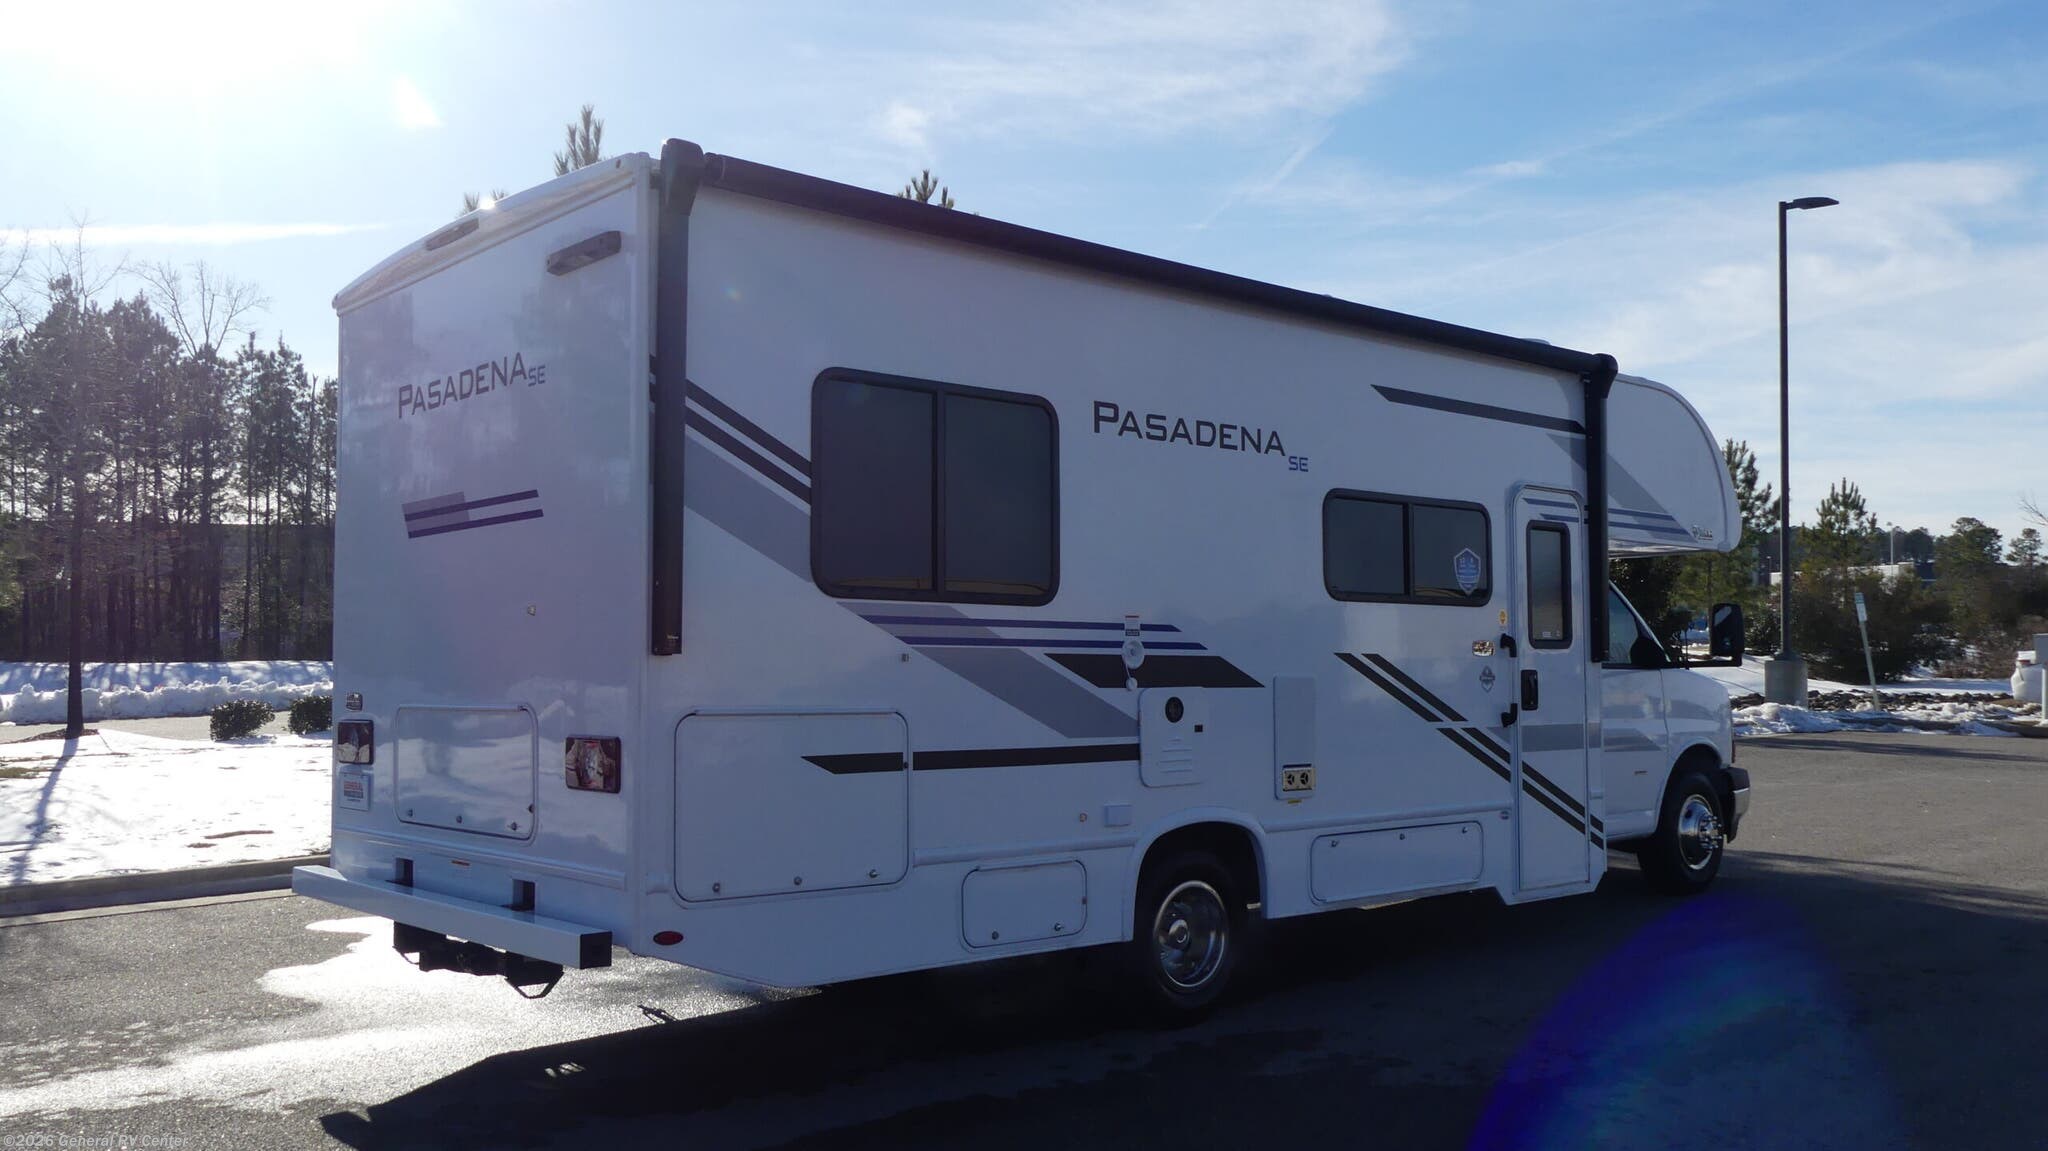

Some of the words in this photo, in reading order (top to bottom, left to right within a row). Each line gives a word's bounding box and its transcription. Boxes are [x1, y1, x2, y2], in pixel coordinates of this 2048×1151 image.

[397, 351, 528, 420] PASADENA
[528, 364, 546, 387] SE
[1093, 400, 1286, 457] PASADENA
[1288, 456, 1309, 472] SE
